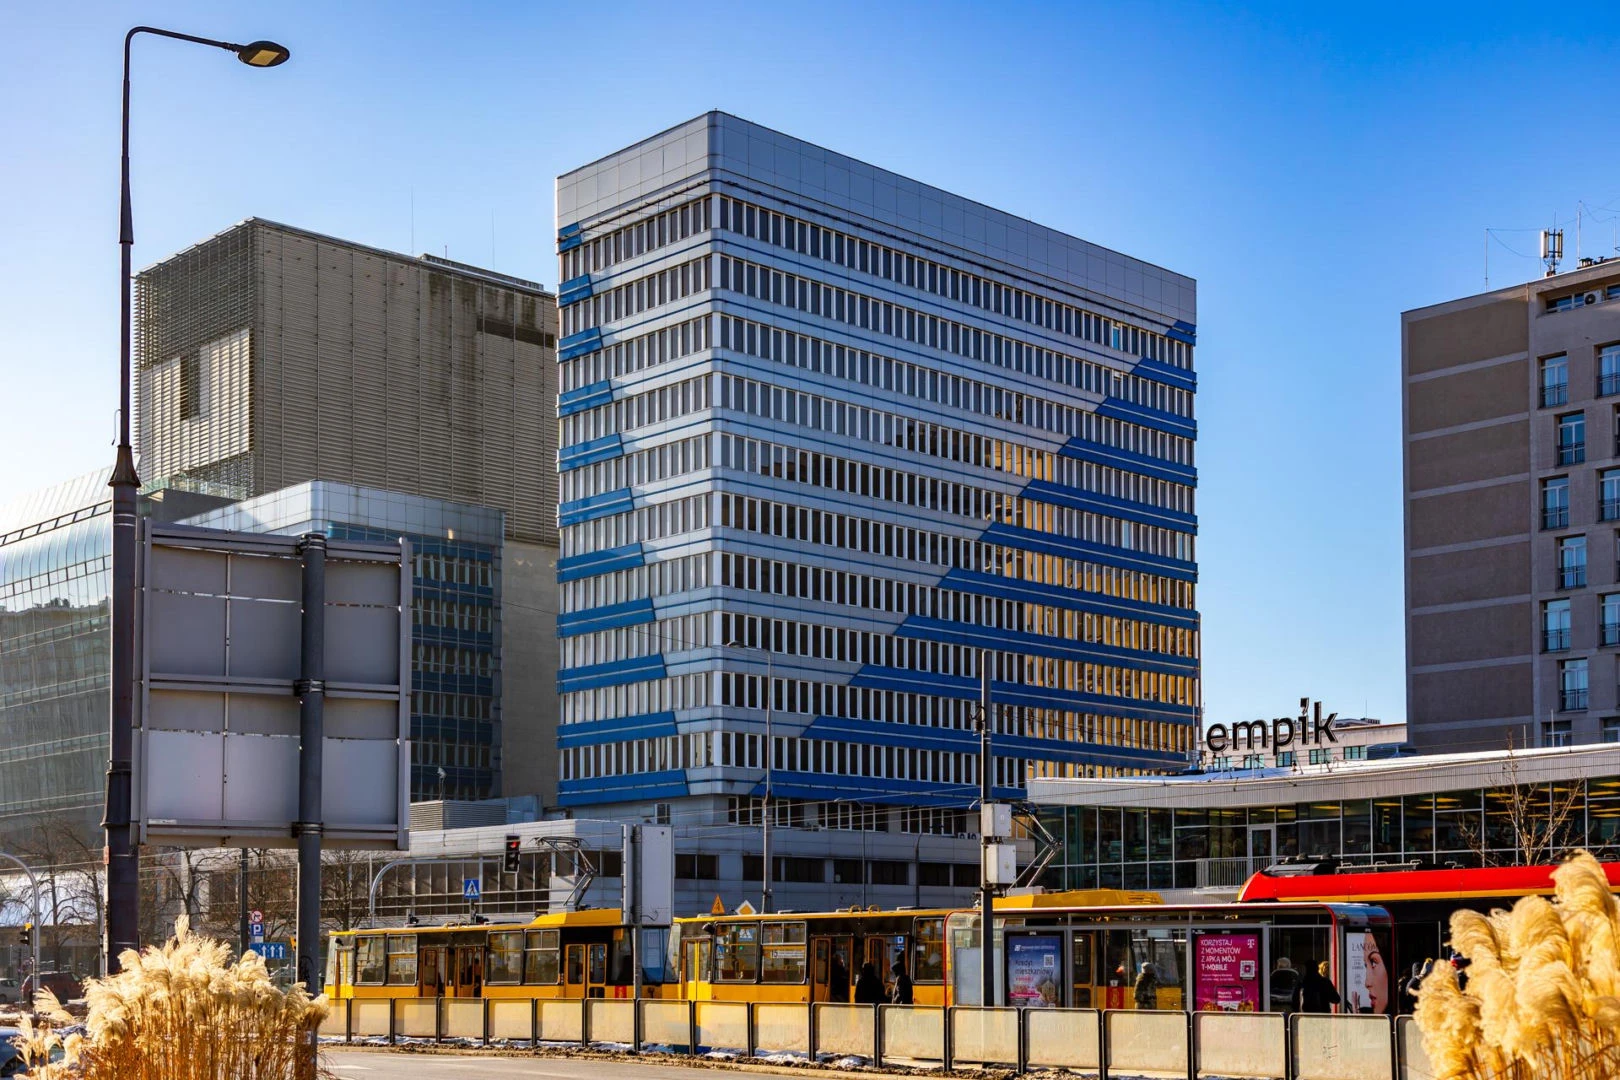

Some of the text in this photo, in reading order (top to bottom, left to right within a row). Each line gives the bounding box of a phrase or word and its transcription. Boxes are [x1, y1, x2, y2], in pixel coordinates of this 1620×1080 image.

[1206, 697, 1338, 756] empik
[253, 924, 261, 935] P
[1206, 946, 1241, 954] MOMENTÓW
[1222, 954, 1236, 962] MÓJ
